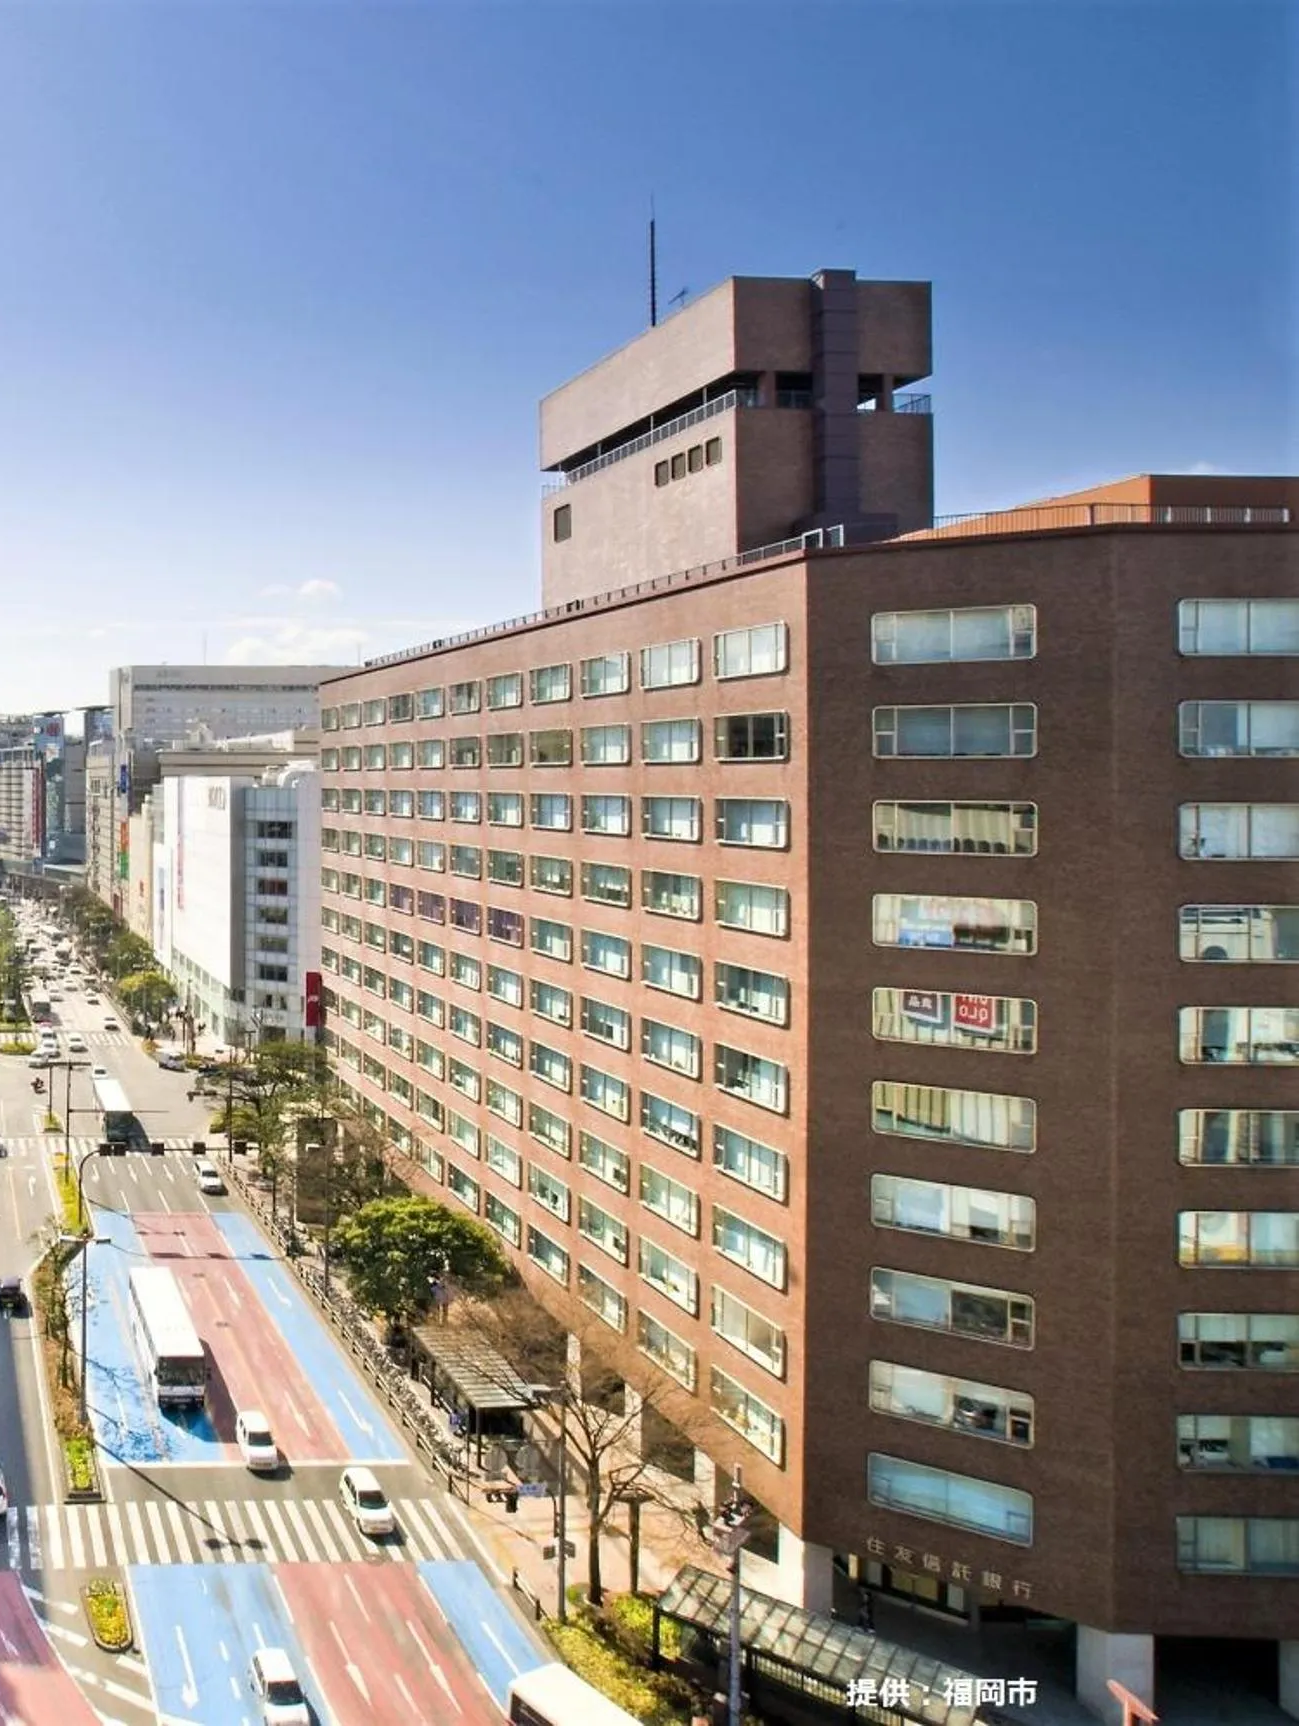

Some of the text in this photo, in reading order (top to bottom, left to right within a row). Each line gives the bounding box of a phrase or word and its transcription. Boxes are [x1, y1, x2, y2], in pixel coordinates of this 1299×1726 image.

[866, 1536, 1032, 1599] 住友信託銀行
